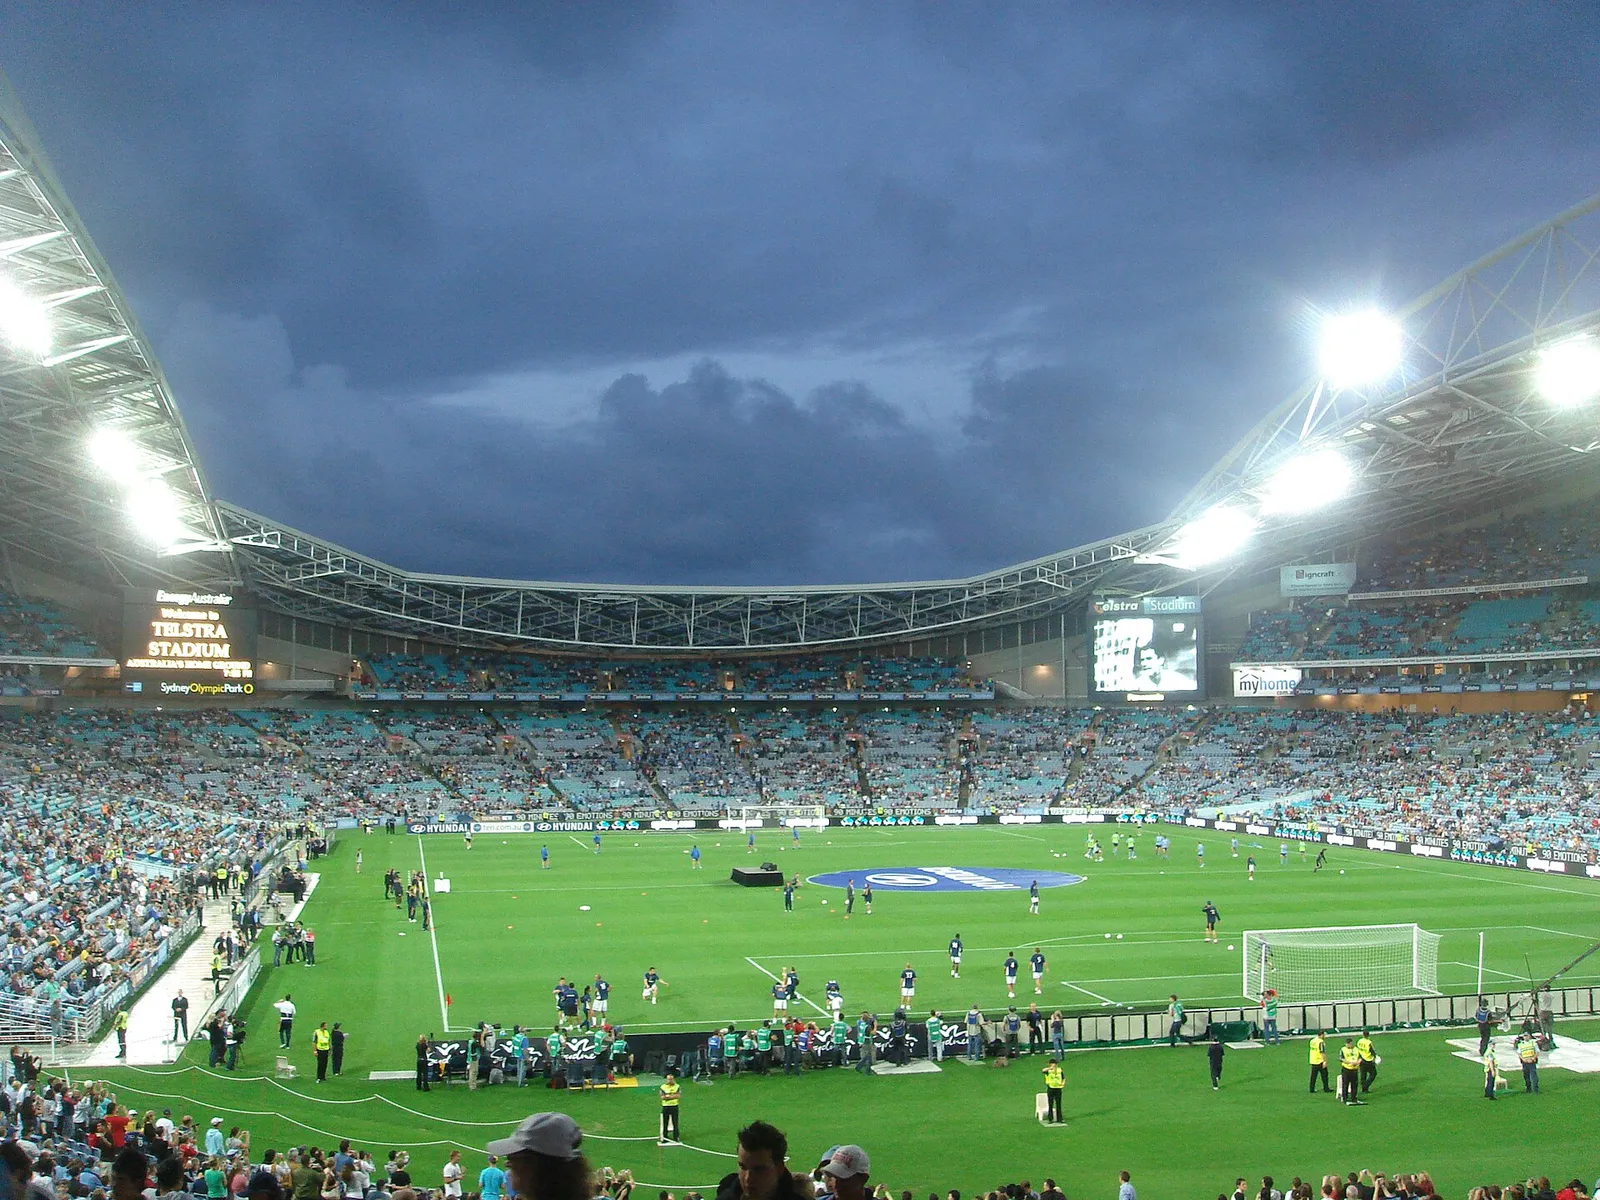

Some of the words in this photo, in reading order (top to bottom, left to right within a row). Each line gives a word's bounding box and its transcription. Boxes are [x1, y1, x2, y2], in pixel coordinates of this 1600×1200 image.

[1150, 599, 1196, 611] Stadium
[161, 608, 207, 620] Welcome
[208, 610, 220, 621] to
[152, 621, 228, 639] TELSTRA
[148, 641, 231, 658] STADIUM
[576, 812, 613, 820] EMOTIONS
[683, 810, 719, 818] EMOTIONS
[427, 824, 468, 833] HYUNDAI
[552, 822, 593, 831] HYUNDAI
[1424, 837, 1449, 847] MINUTES
[1452, 840, 1461, 849] 90
[1461, 841, 1489, 851] EMOTION
[1542, 849, 1551, 859] 90
[1553, 850, 1588, 863] EMOTIONS
